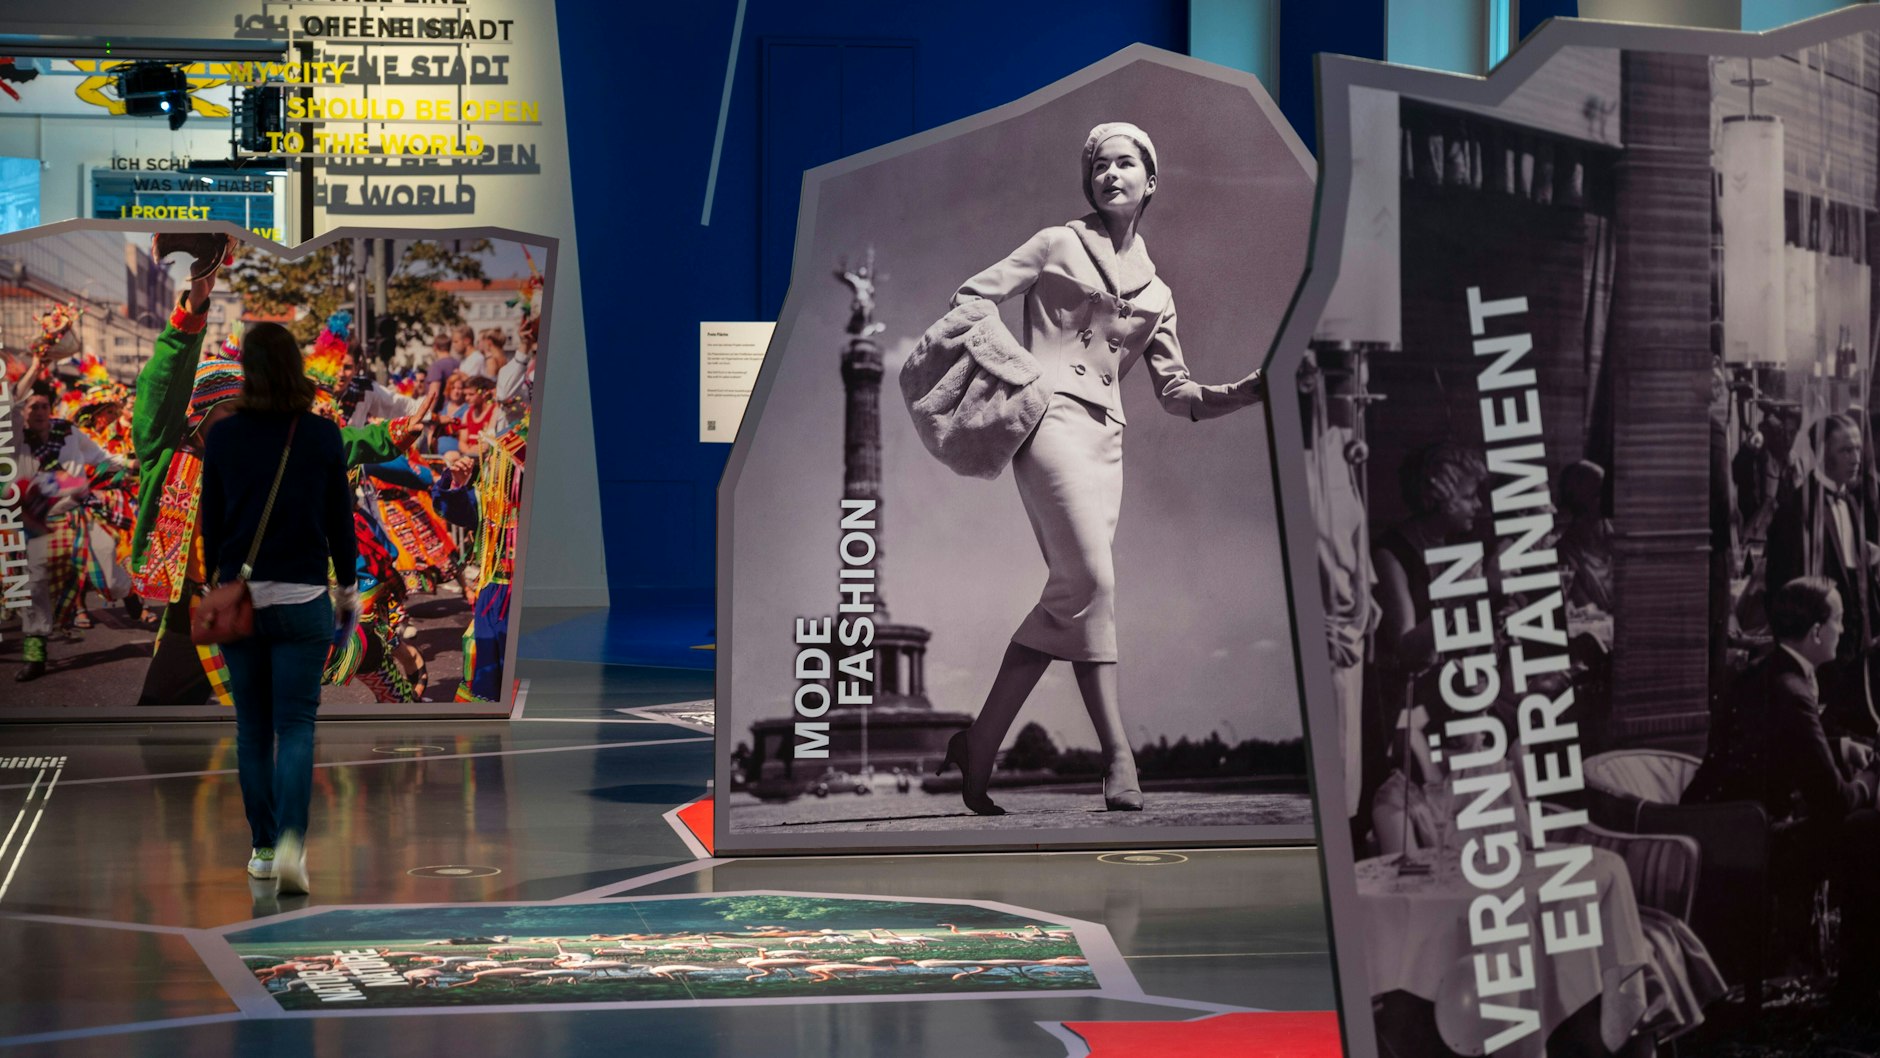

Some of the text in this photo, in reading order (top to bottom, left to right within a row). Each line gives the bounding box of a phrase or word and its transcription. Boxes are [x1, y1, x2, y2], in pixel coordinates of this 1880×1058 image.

[303, 15, 514, 41] OFFENE STADT
[230, 61, 270, 83] MY
[283, 62, 348, 85] CITY
[287, 97, 539, 122] SHOULD BE OPEN
[266, 131, 485, 156] TO THE WORLD
[111, 154, 191, 171] ICH SCHÜ
[134, 178, 274, 194] WAS WIR HABEN
[120, 206, 211, 220] I PROTECT
[251, 227, 282, 241] AVE
[838, 500, 876, 704] FASHION
[1466, 286, 1604, 954] ENTERTAINMENT
[794, 617, 832, 758] MODE
[1424, 541, 1541, 1056] VERGNÜGEN
